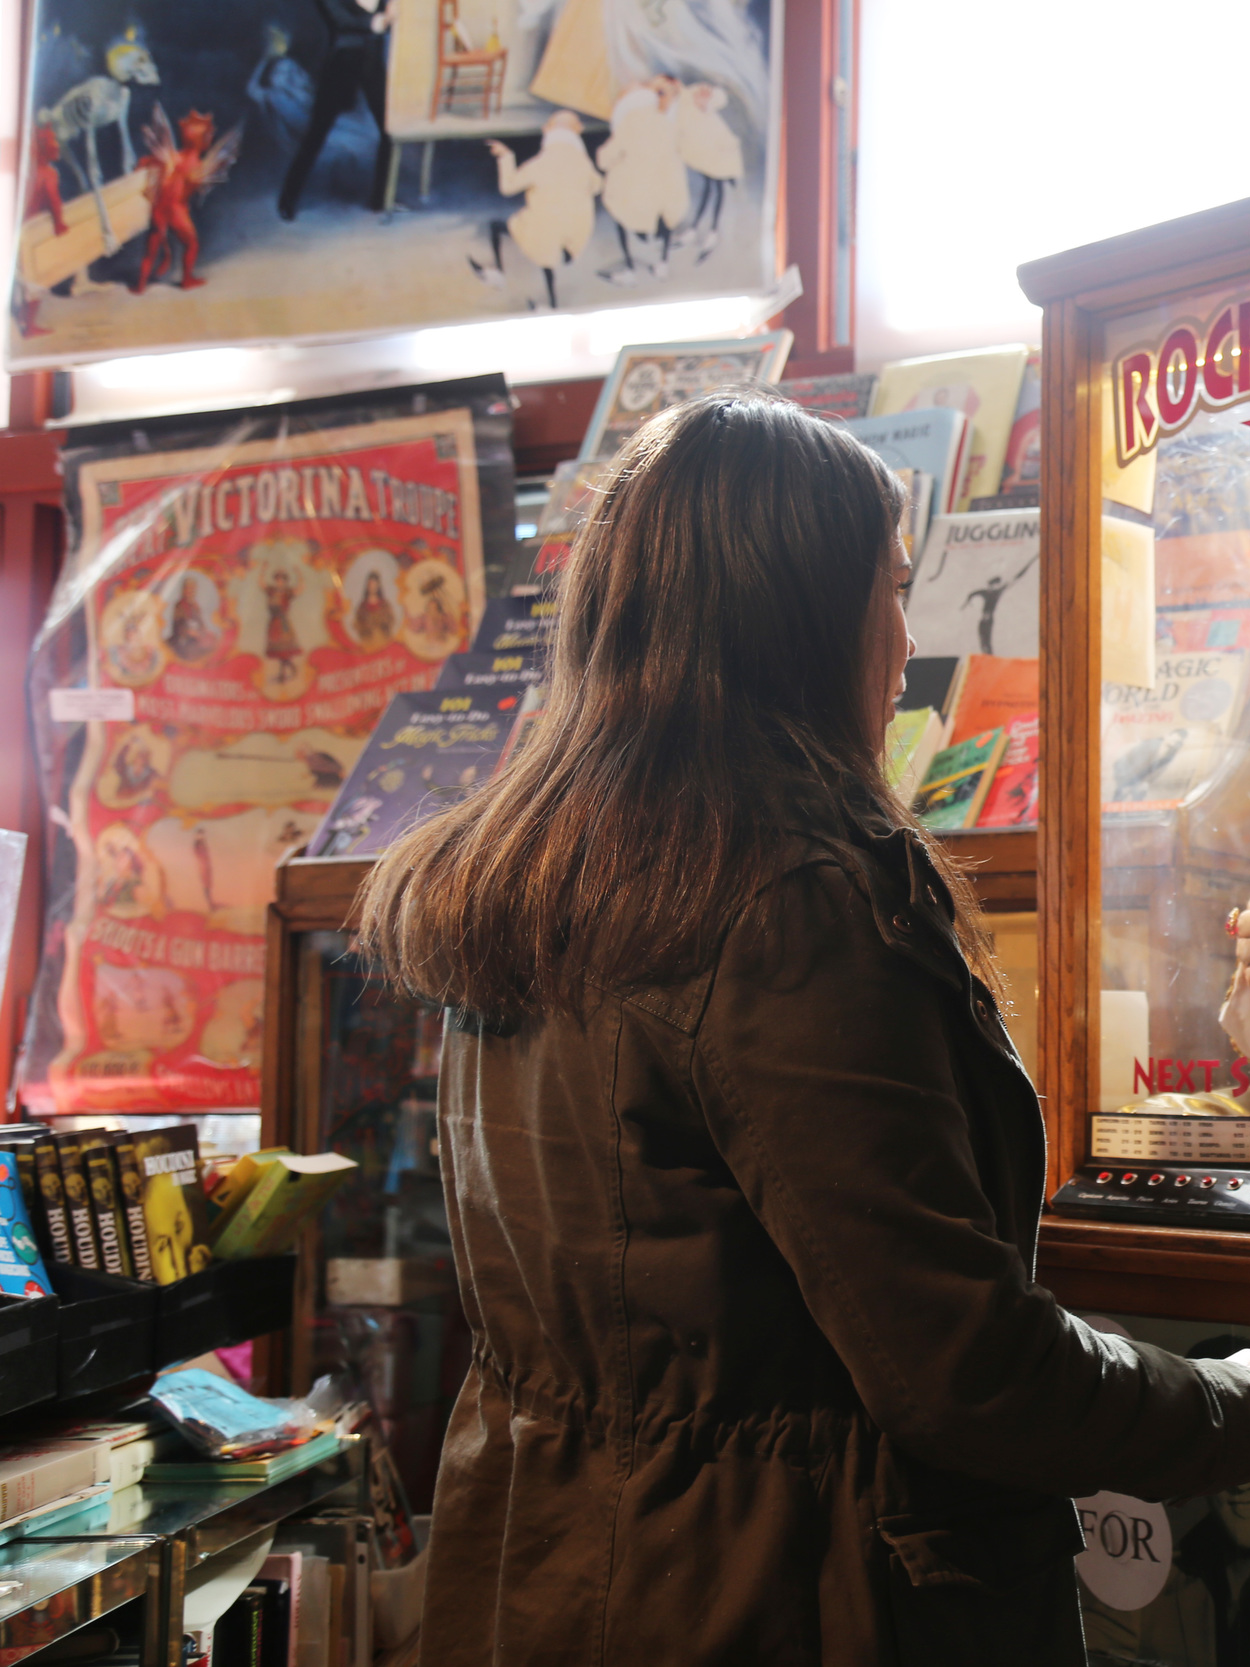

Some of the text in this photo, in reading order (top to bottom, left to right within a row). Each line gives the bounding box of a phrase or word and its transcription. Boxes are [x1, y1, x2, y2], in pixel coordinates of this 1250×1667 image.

[174, 466, 374, 546] VICTORINA
[371, 470, 460, 541] TROUPE
[946, 522, 1040, 546] JUGGLIN
[1155, 657, 1222, 680] AGIC
[440, 697, 472, 713] 101
[1103, 681, 1180, 706] ORLD
[410, 711, 490, 724] Easy-to-Do
[208, 941, 267, 974] BARRE
[1133, 1055, 1220, 1096] NEXT
[47, 1207, 70, 1264] HOUD
[72, 1207, 98, 1270] HOUDI
[98, 1211, 122, 1275] HOUDI
[126, 1205, 152, 1281] HOUDIN
[1080, 1509, 1161, 1563] FOR
